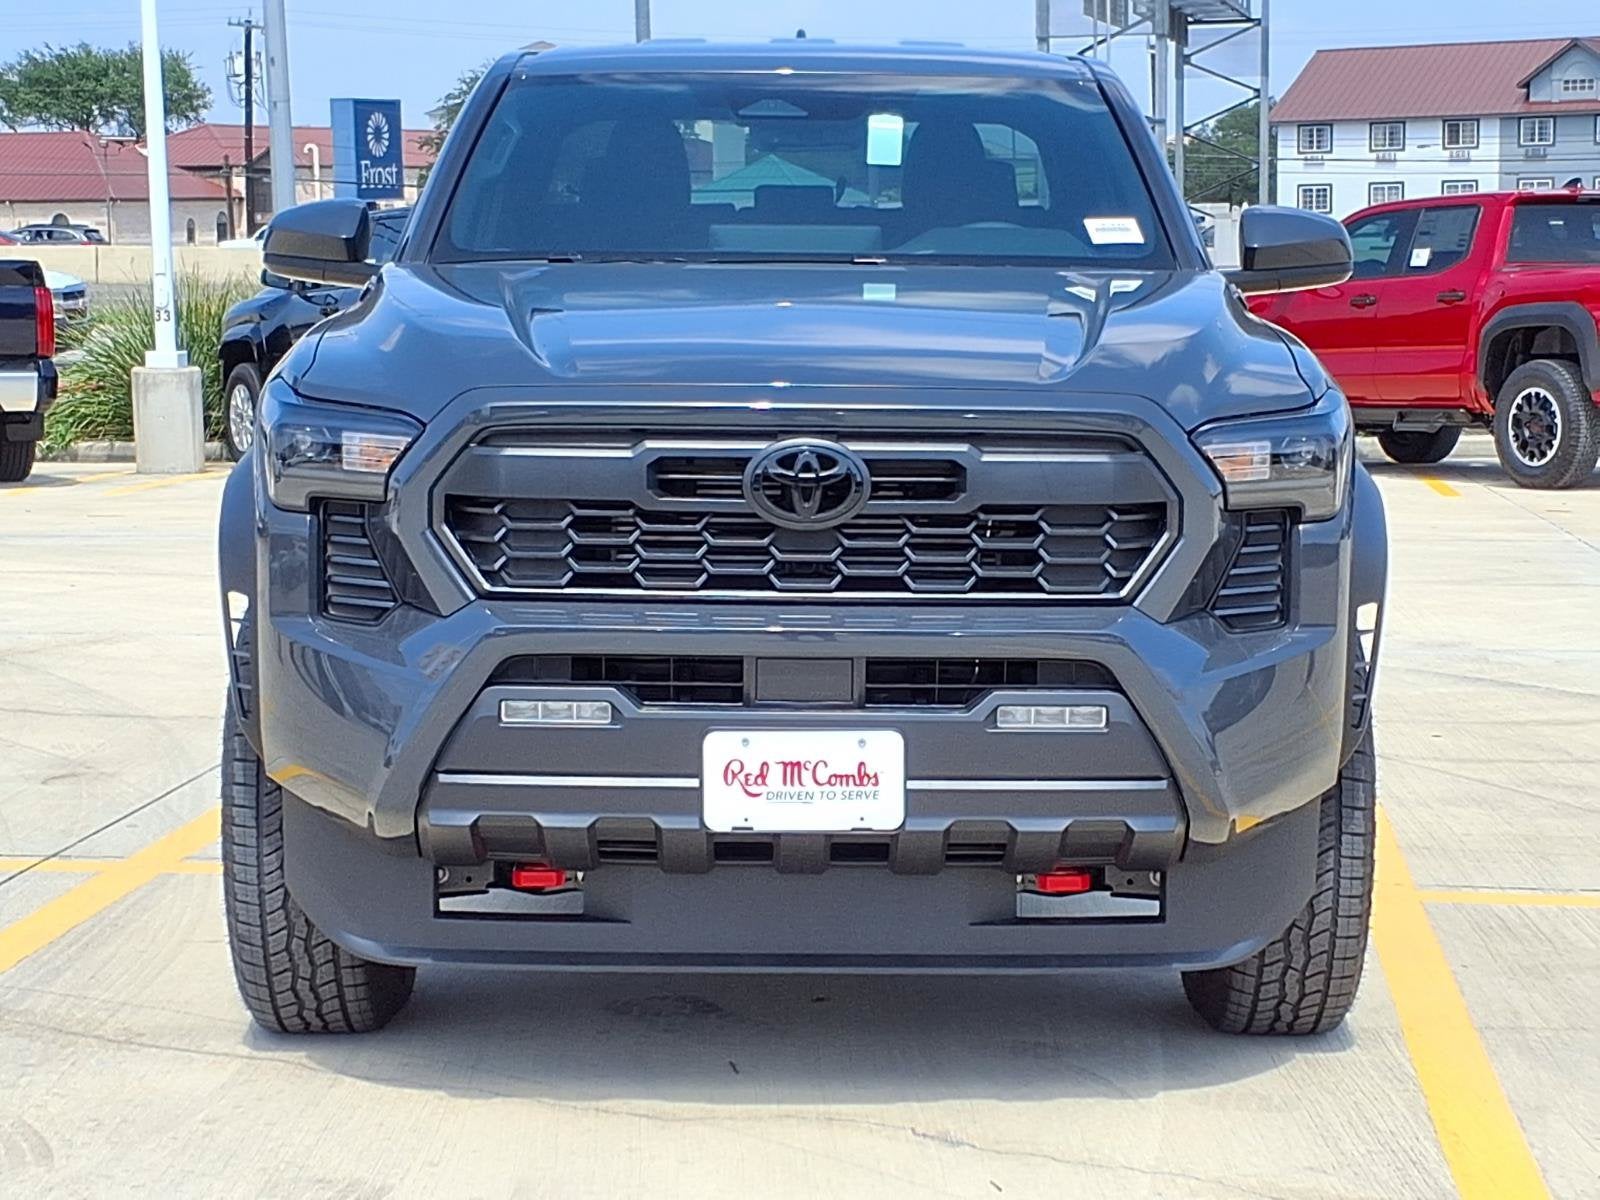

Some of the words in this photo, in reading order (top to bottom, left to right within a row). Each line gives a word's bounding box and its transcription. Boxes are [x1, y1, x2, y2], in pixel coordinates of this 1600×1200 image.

[360, 160, 399, 189] Frost
[723, 758, 770, 798] Red
[774, 759, 880, 787] McCombs
[765, 790, 815, 801] DRIVEN
[820, 790, 837, 801] TO
[841, 789, 880, 800] SERVE
